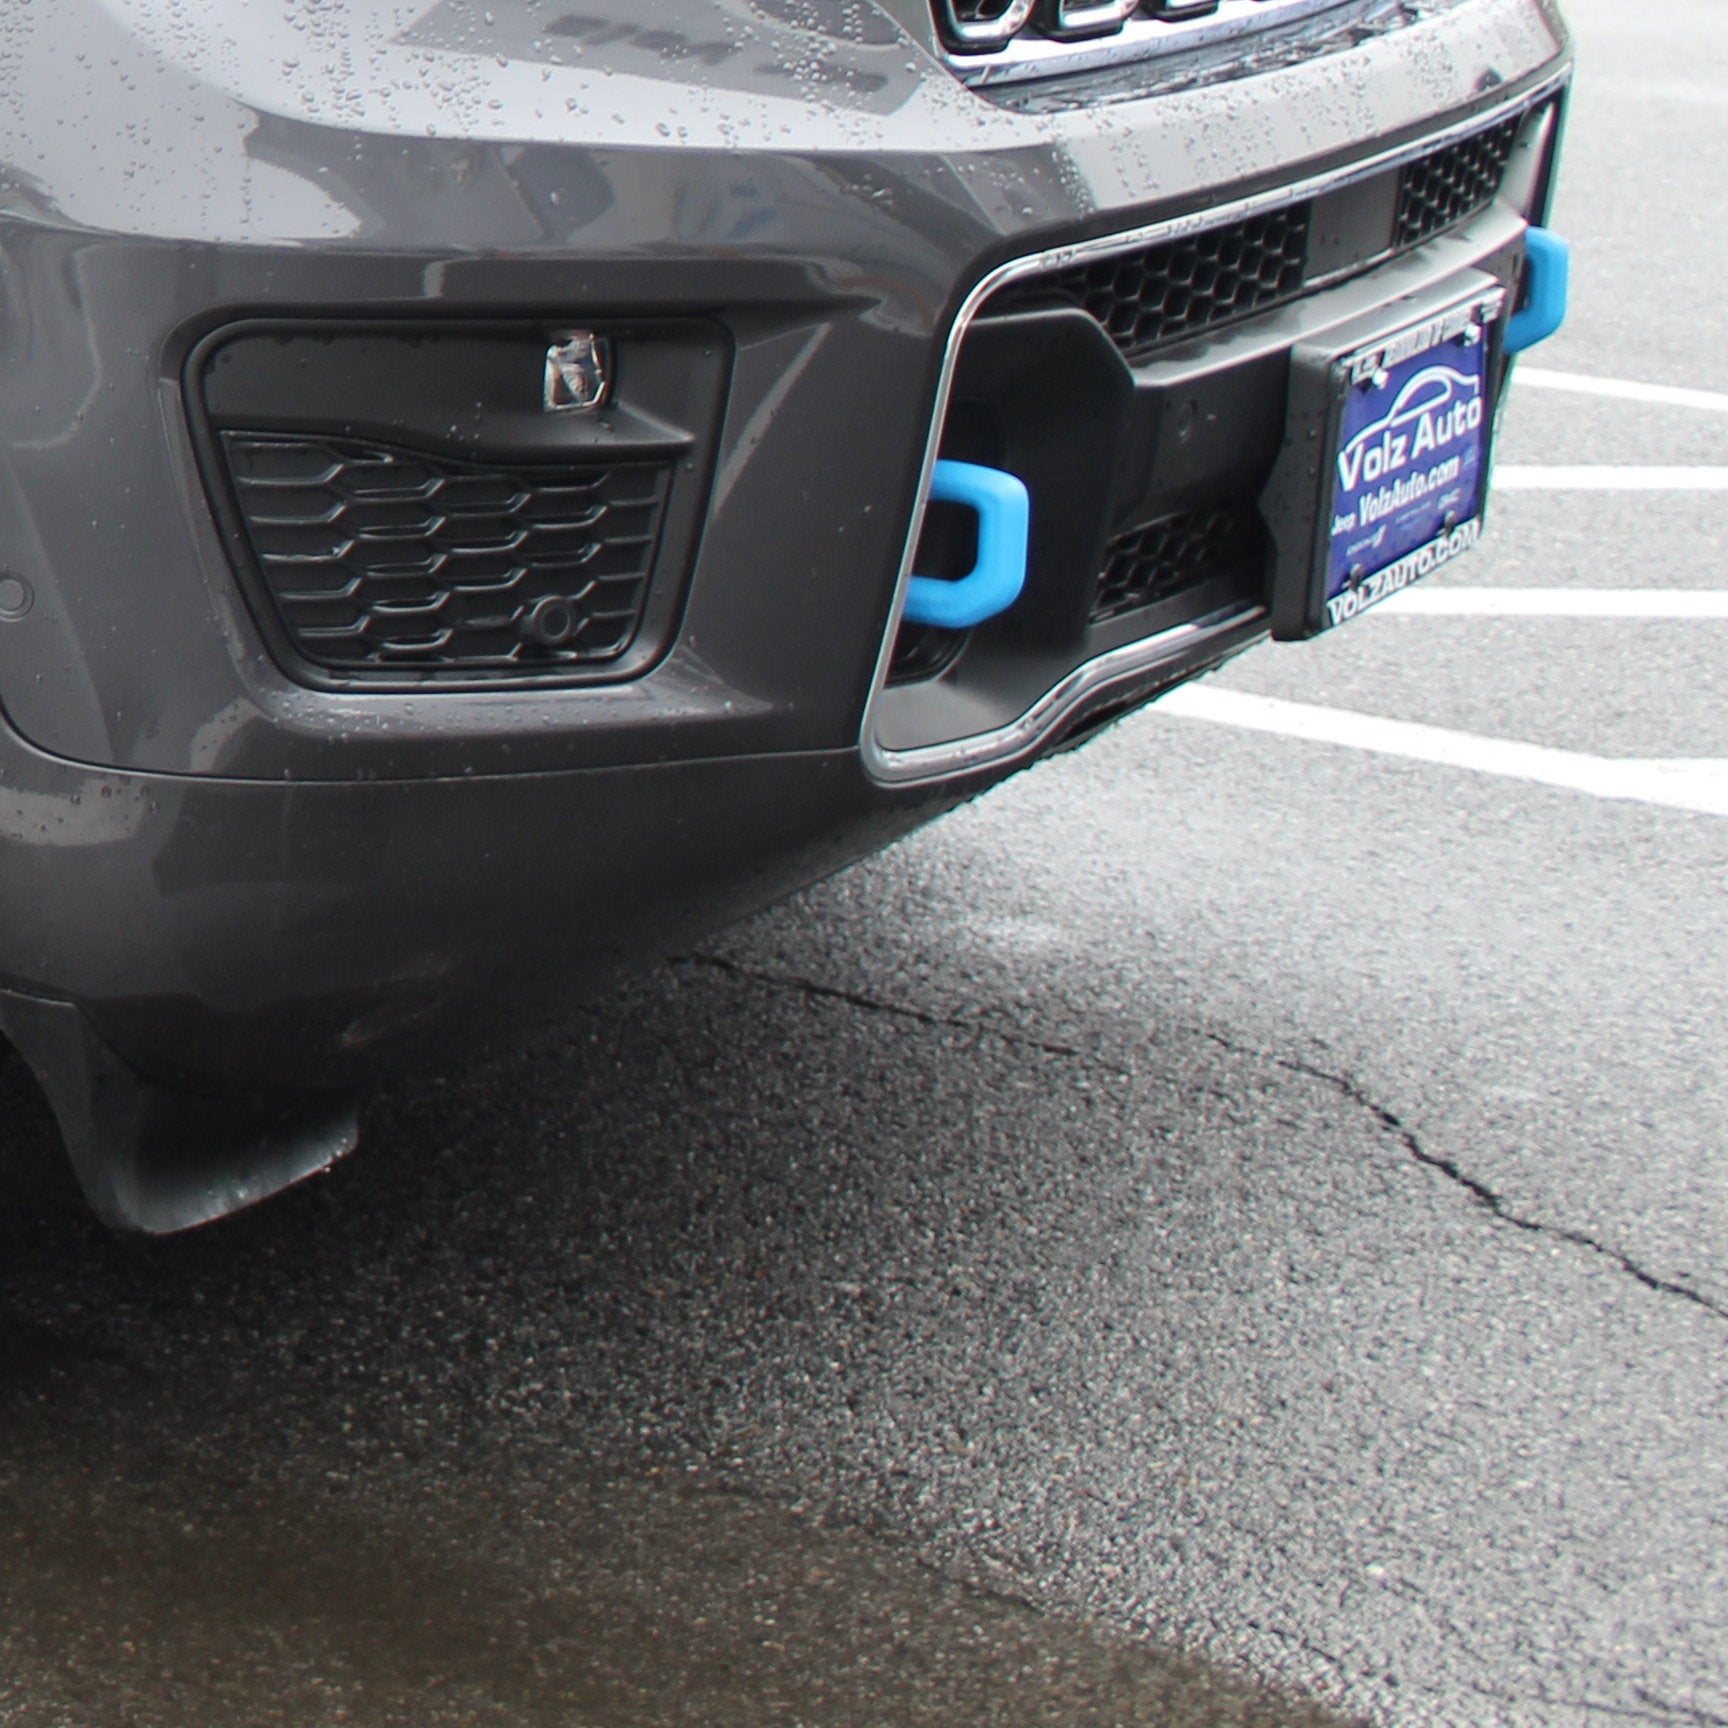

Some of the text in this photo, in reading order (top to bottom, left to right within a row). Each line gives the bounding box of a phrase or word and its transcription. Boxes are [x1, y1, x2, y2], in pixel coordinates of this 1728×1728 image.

[1337, 430, 1408, 492] Volz
[1410, 395, 1483, 460] Auto
[1359, 454, 1461, 527] VolzAuto.com
[1326, 515, 1482, 626] VOLZAUTO.COM
